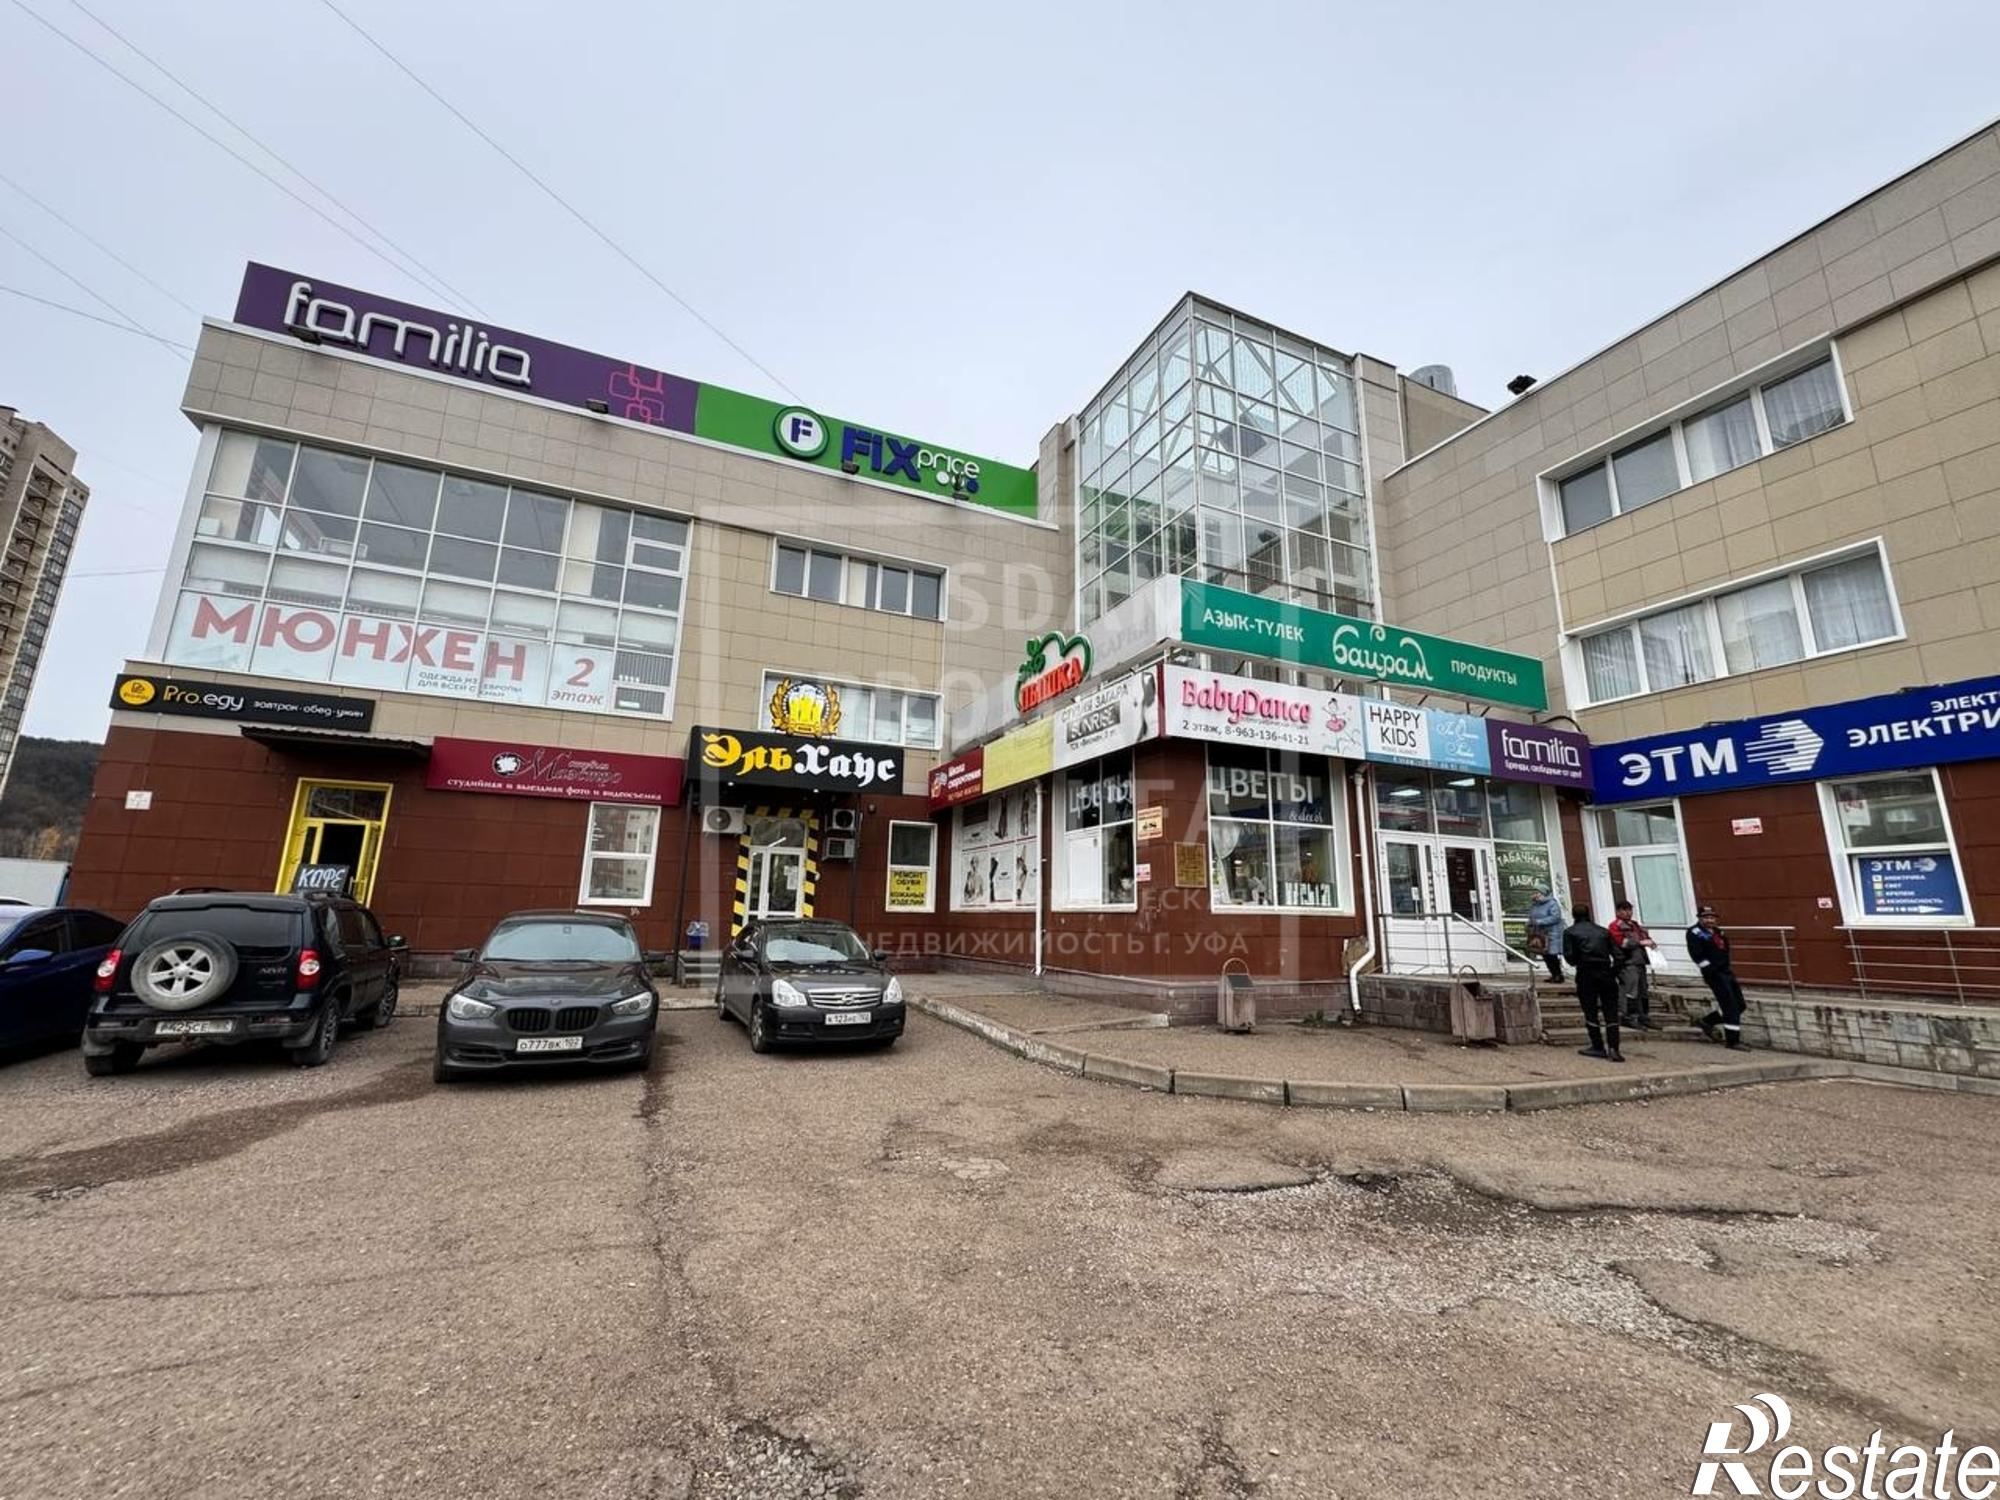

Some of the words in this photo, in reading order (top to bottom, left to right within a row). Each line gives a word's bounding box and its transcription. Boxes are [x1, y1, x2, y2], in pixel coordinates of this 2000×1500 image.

[284, 282, 532, 386] familia
[791, 417, 813, 443] F
[917, 449, 980, 479] price
[191, 597, 527, 682] МЮНХЕН
[417, 680, 440, 688] ДЛЯ
[418, 671, 463, 684] ОДЕЖДА
[566, 657, 595, 687] 2
[1019, 657, 1083, 712] ПЫШКА
[1450, 659, 1518, 686] ПРОДУКТЫ
[551, 689, 604, 705] этаж
[1181, 679, 1312, 725] BabyDance
[1930, 690, 2000, 713] ЭЛЕКТ
[303, 703, 333, 717] обед
[1369, 705, 1421, 729] HAPPY
[1182, 719, 1190, 730] 2
[1192, 723, 1223, 735] этаж,
[1379, 725, 1417, 748] KIDS
[1501, 728, 1581, 767] familia
[1619, 737, 1738, 787] ЭТМ
[446, 778, 503, 789] студийная
[516, 784, 564, 793] выездная
[566, 785, 591, 797] фото
[1208, 766, 1314, 806] ЦВЕТЫ
[893, 871, 924, 879] РЕМОНТ
[1871, 860, 1912, 872] ЭТМ
